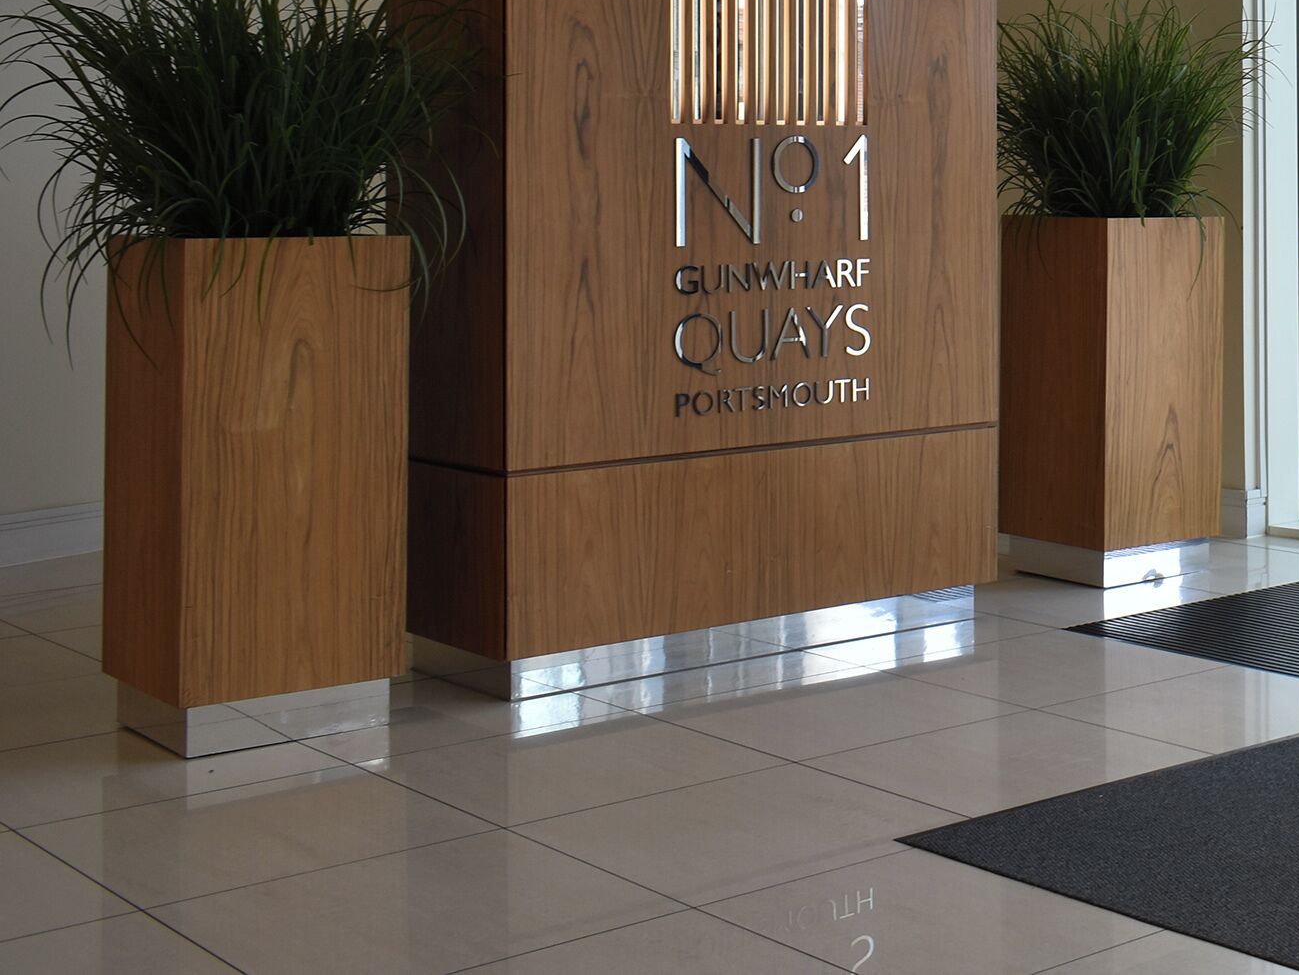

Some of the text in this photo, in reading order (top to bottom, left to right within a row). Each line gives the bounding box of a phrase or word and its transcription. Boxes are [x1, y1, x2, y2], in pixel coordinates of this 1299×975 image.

[675, 258, 871, 295] GUNWHARF
[674, 304, 871, 375] QUAYS
[675, 378, 870, 417] PORTSMOUTH
